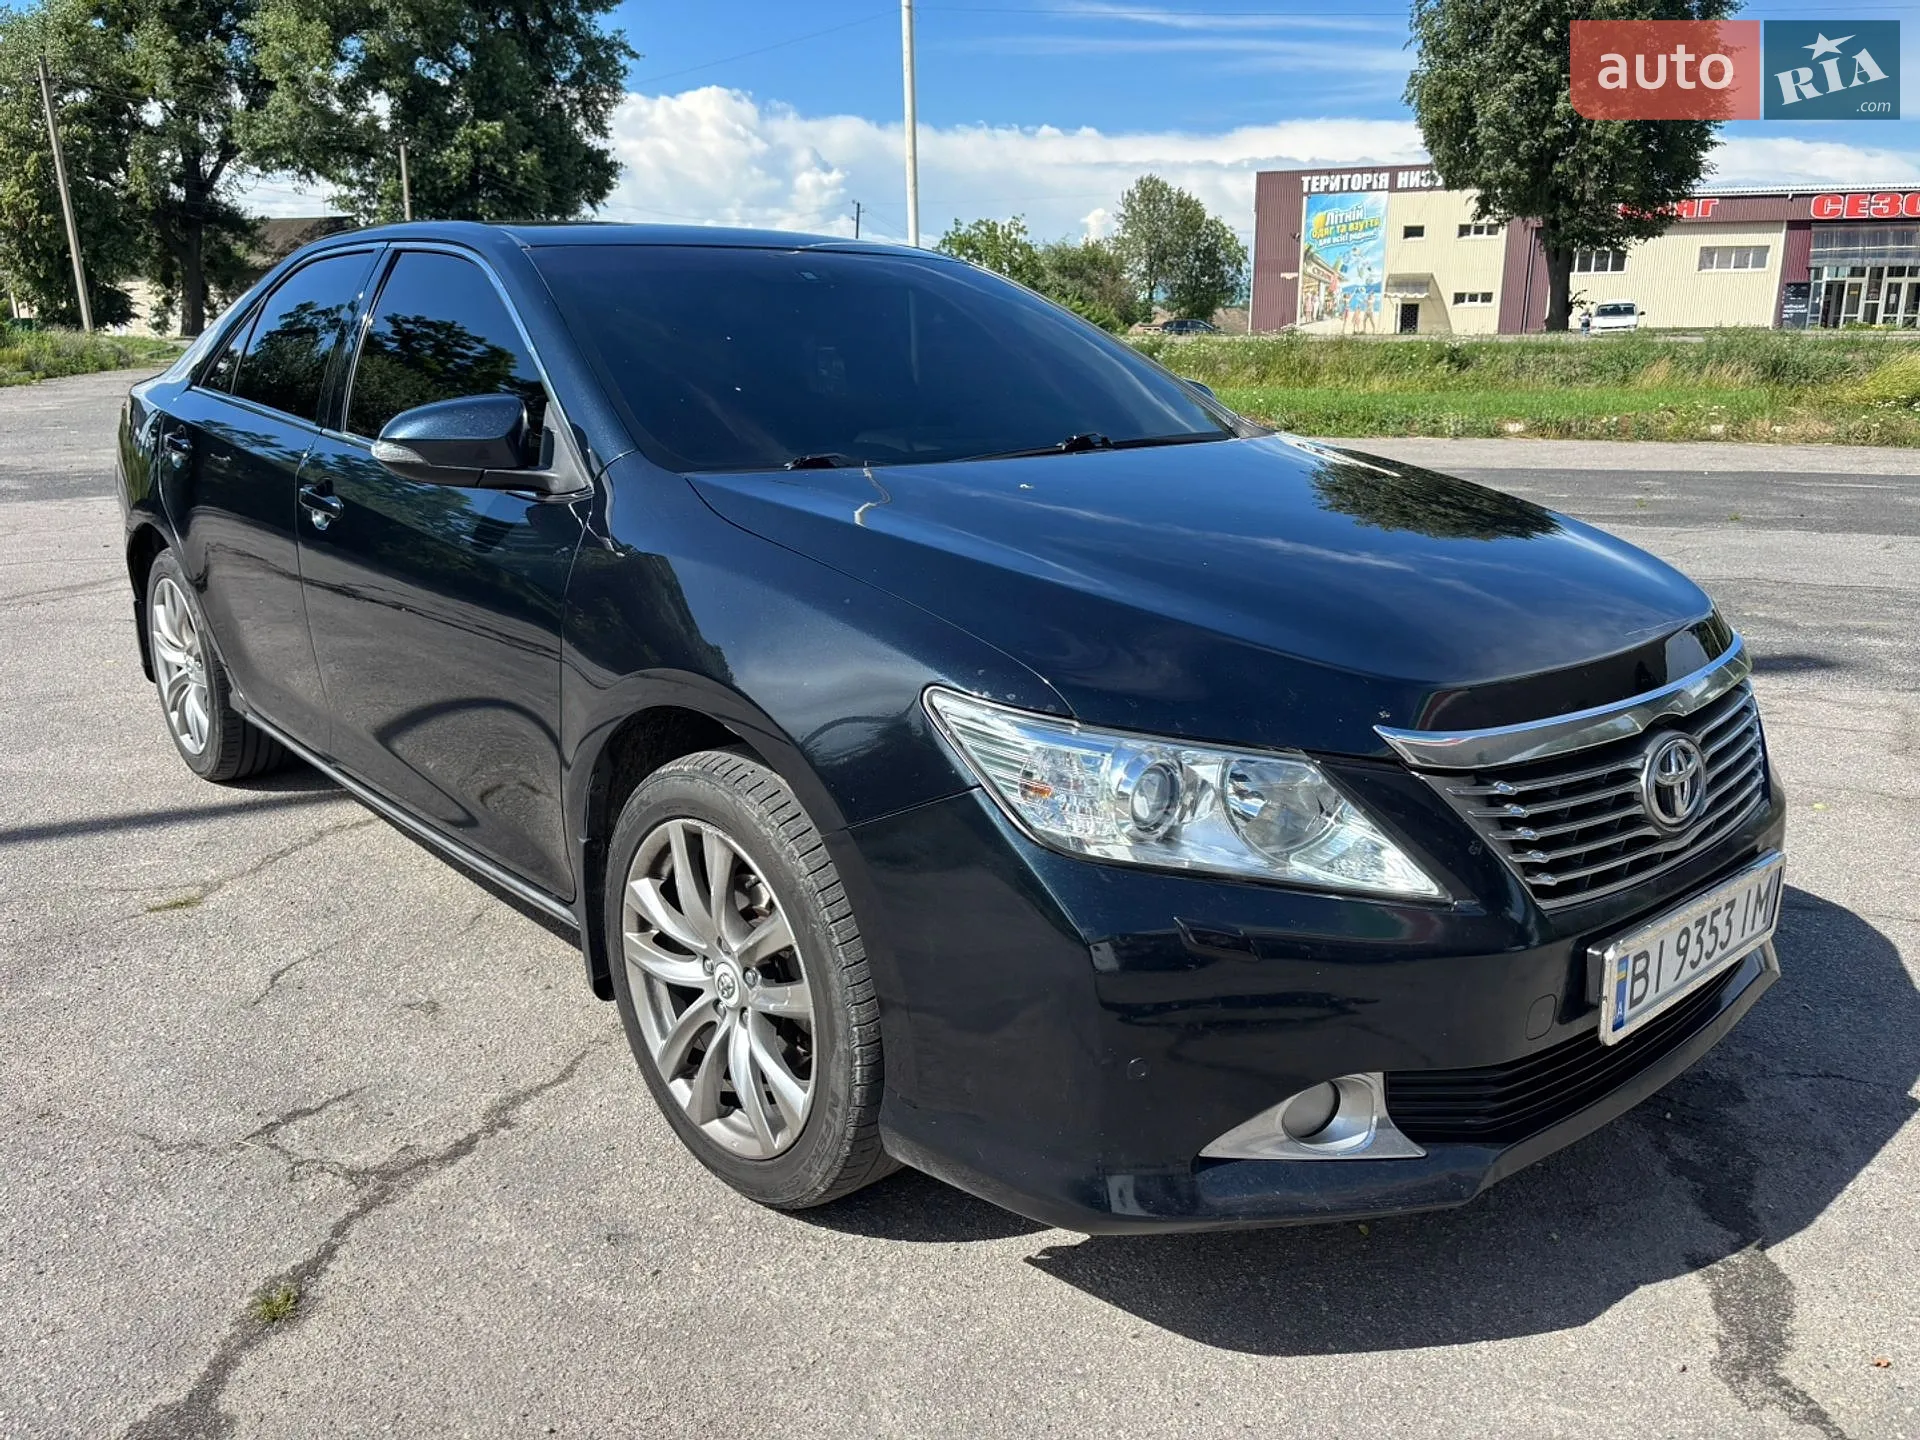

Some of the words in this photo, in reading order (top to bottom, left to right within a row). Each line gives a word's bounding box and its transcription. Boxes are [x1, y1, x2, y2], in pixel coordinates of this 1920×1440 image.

[1302, 172, 1390, 193] ТЕРИТОРІЯ
[1629, 939, 1664, 1010] BI
[1674, 898, 1736, 982] 9353
[1740, 875, 1773, 938] IM
